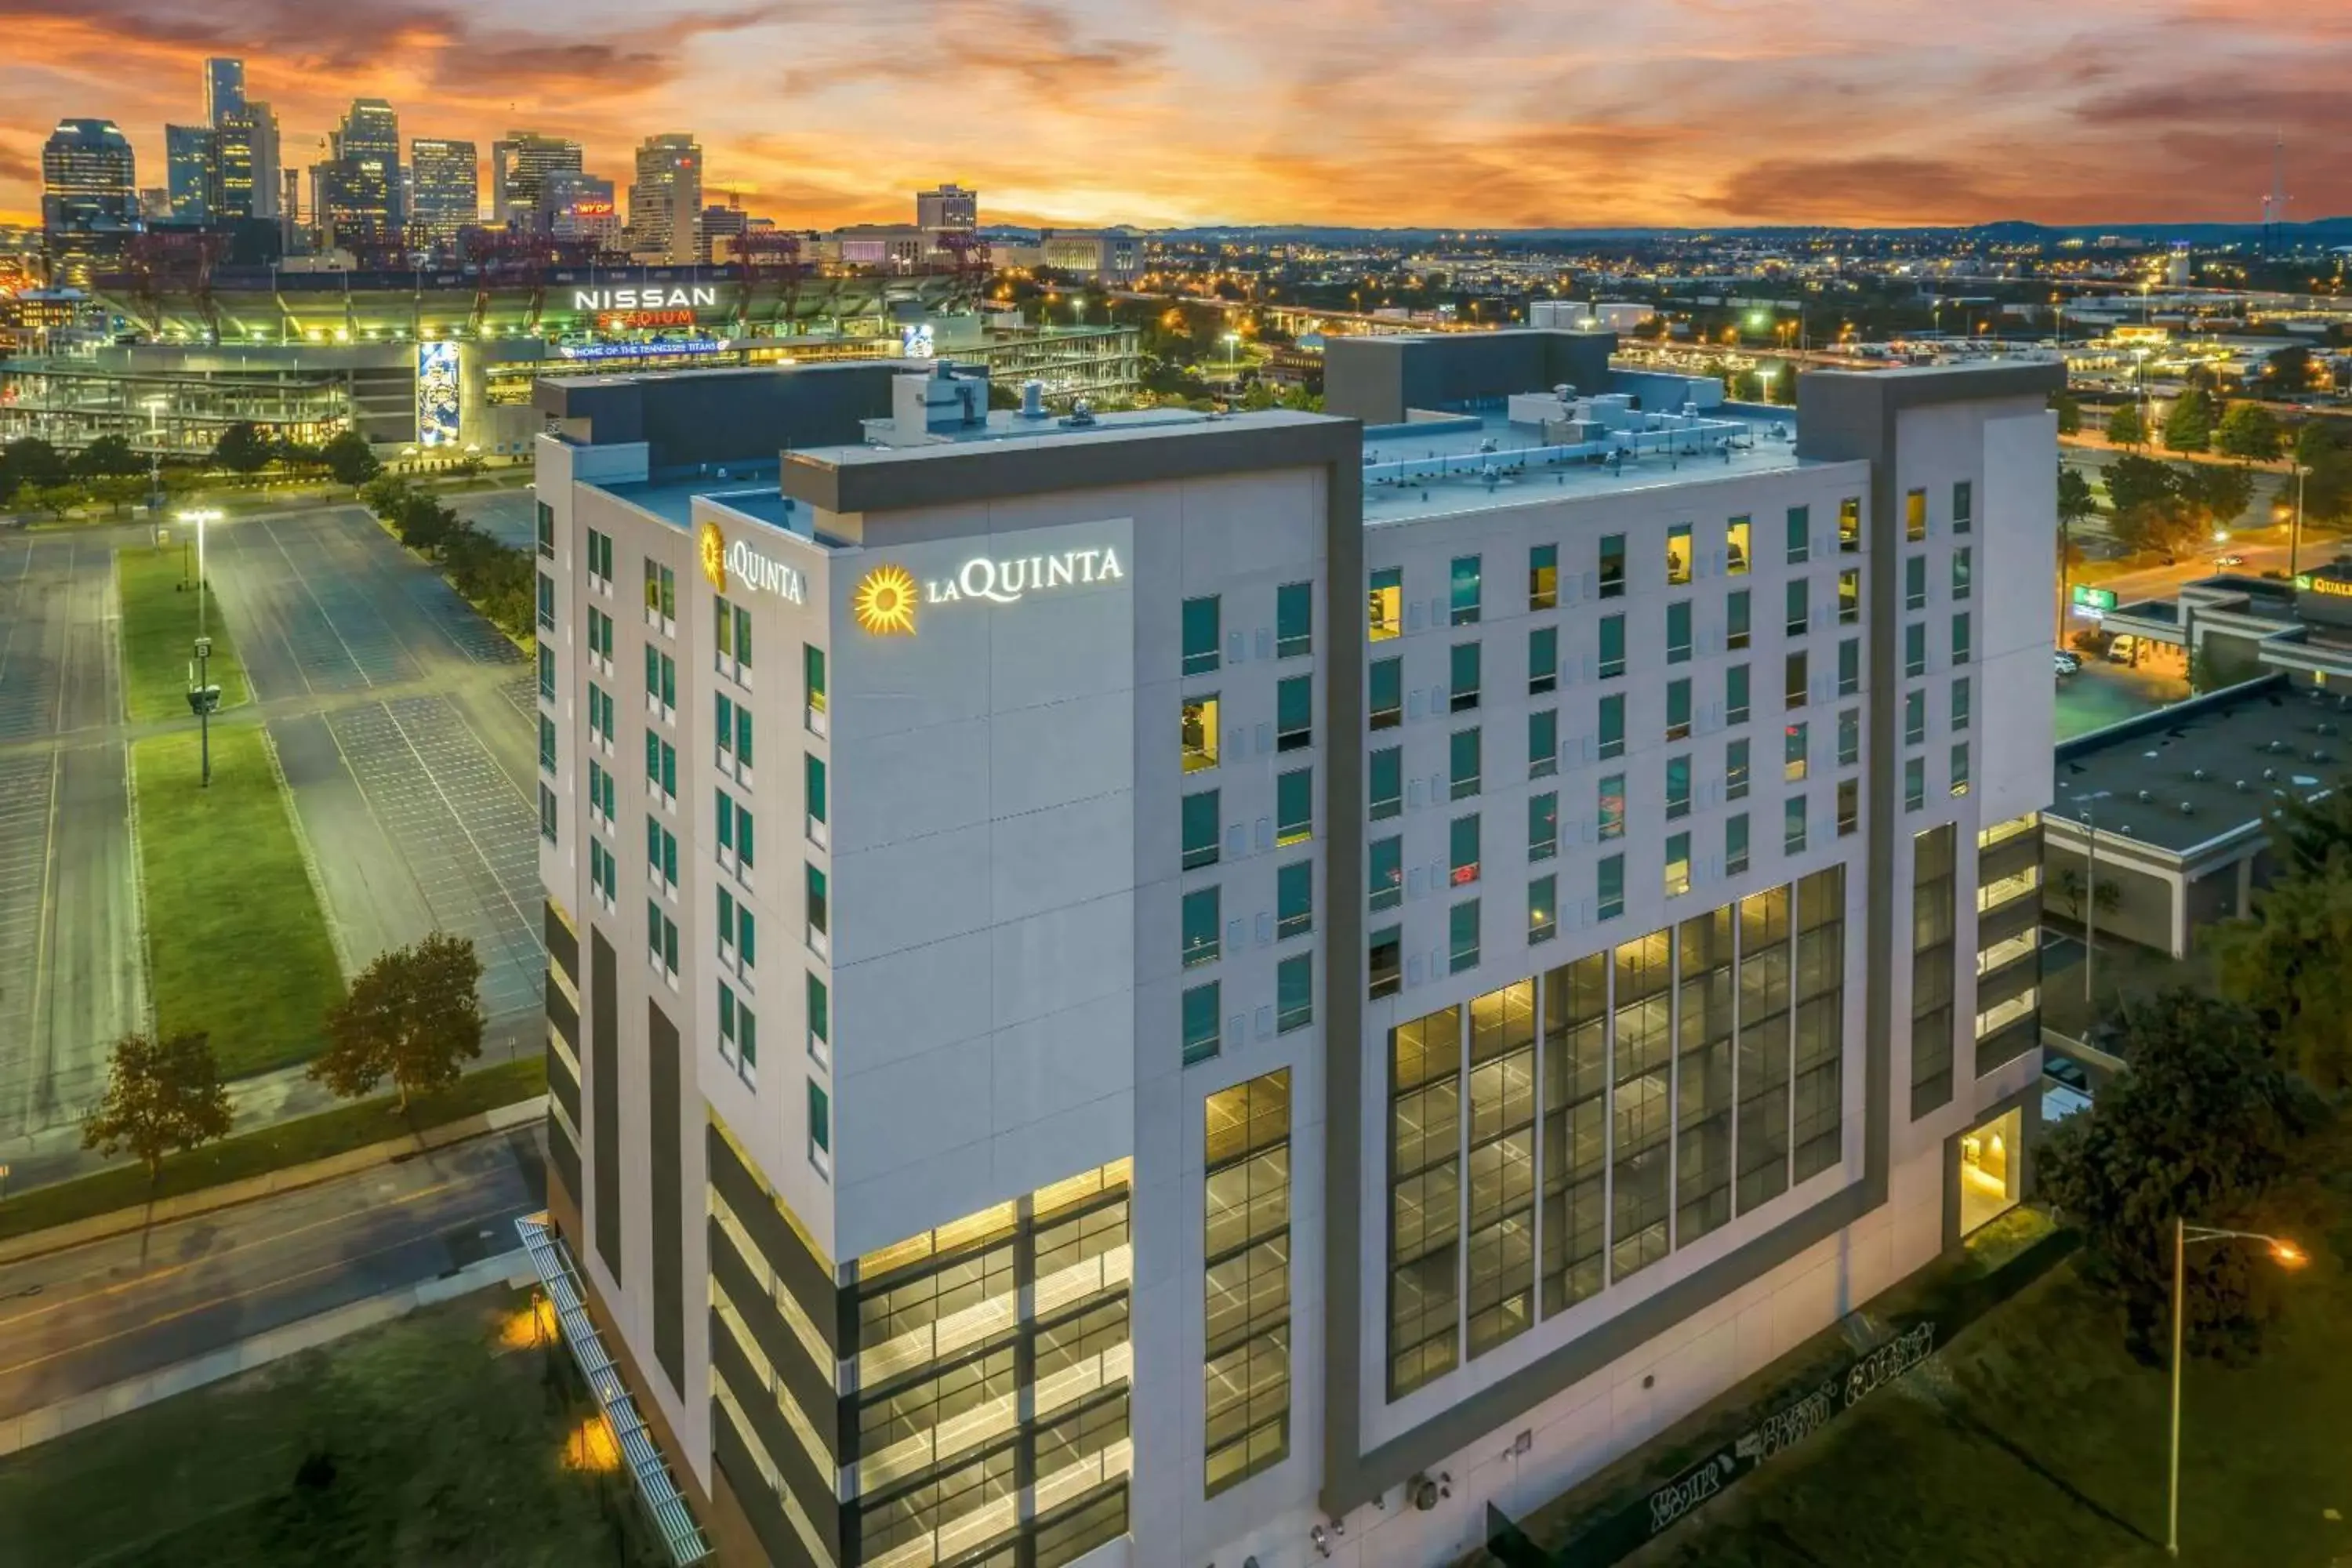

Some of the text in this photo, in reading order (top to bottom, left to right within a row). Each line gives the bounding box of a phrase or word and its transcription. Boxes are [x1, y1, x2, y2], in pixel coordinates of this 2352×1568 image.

[575, 288, 715, 310] NISSAN
[577, 347, 603, 356] HOME
[604, 347, 619, 355] OF
[621, 346, 638, 354] THE
[640, 344, 686, 353] TENNESSEE
[723, 540, 802, 605] LA QUINTA
[927, 546, 1124, 603] LA QUINTA
